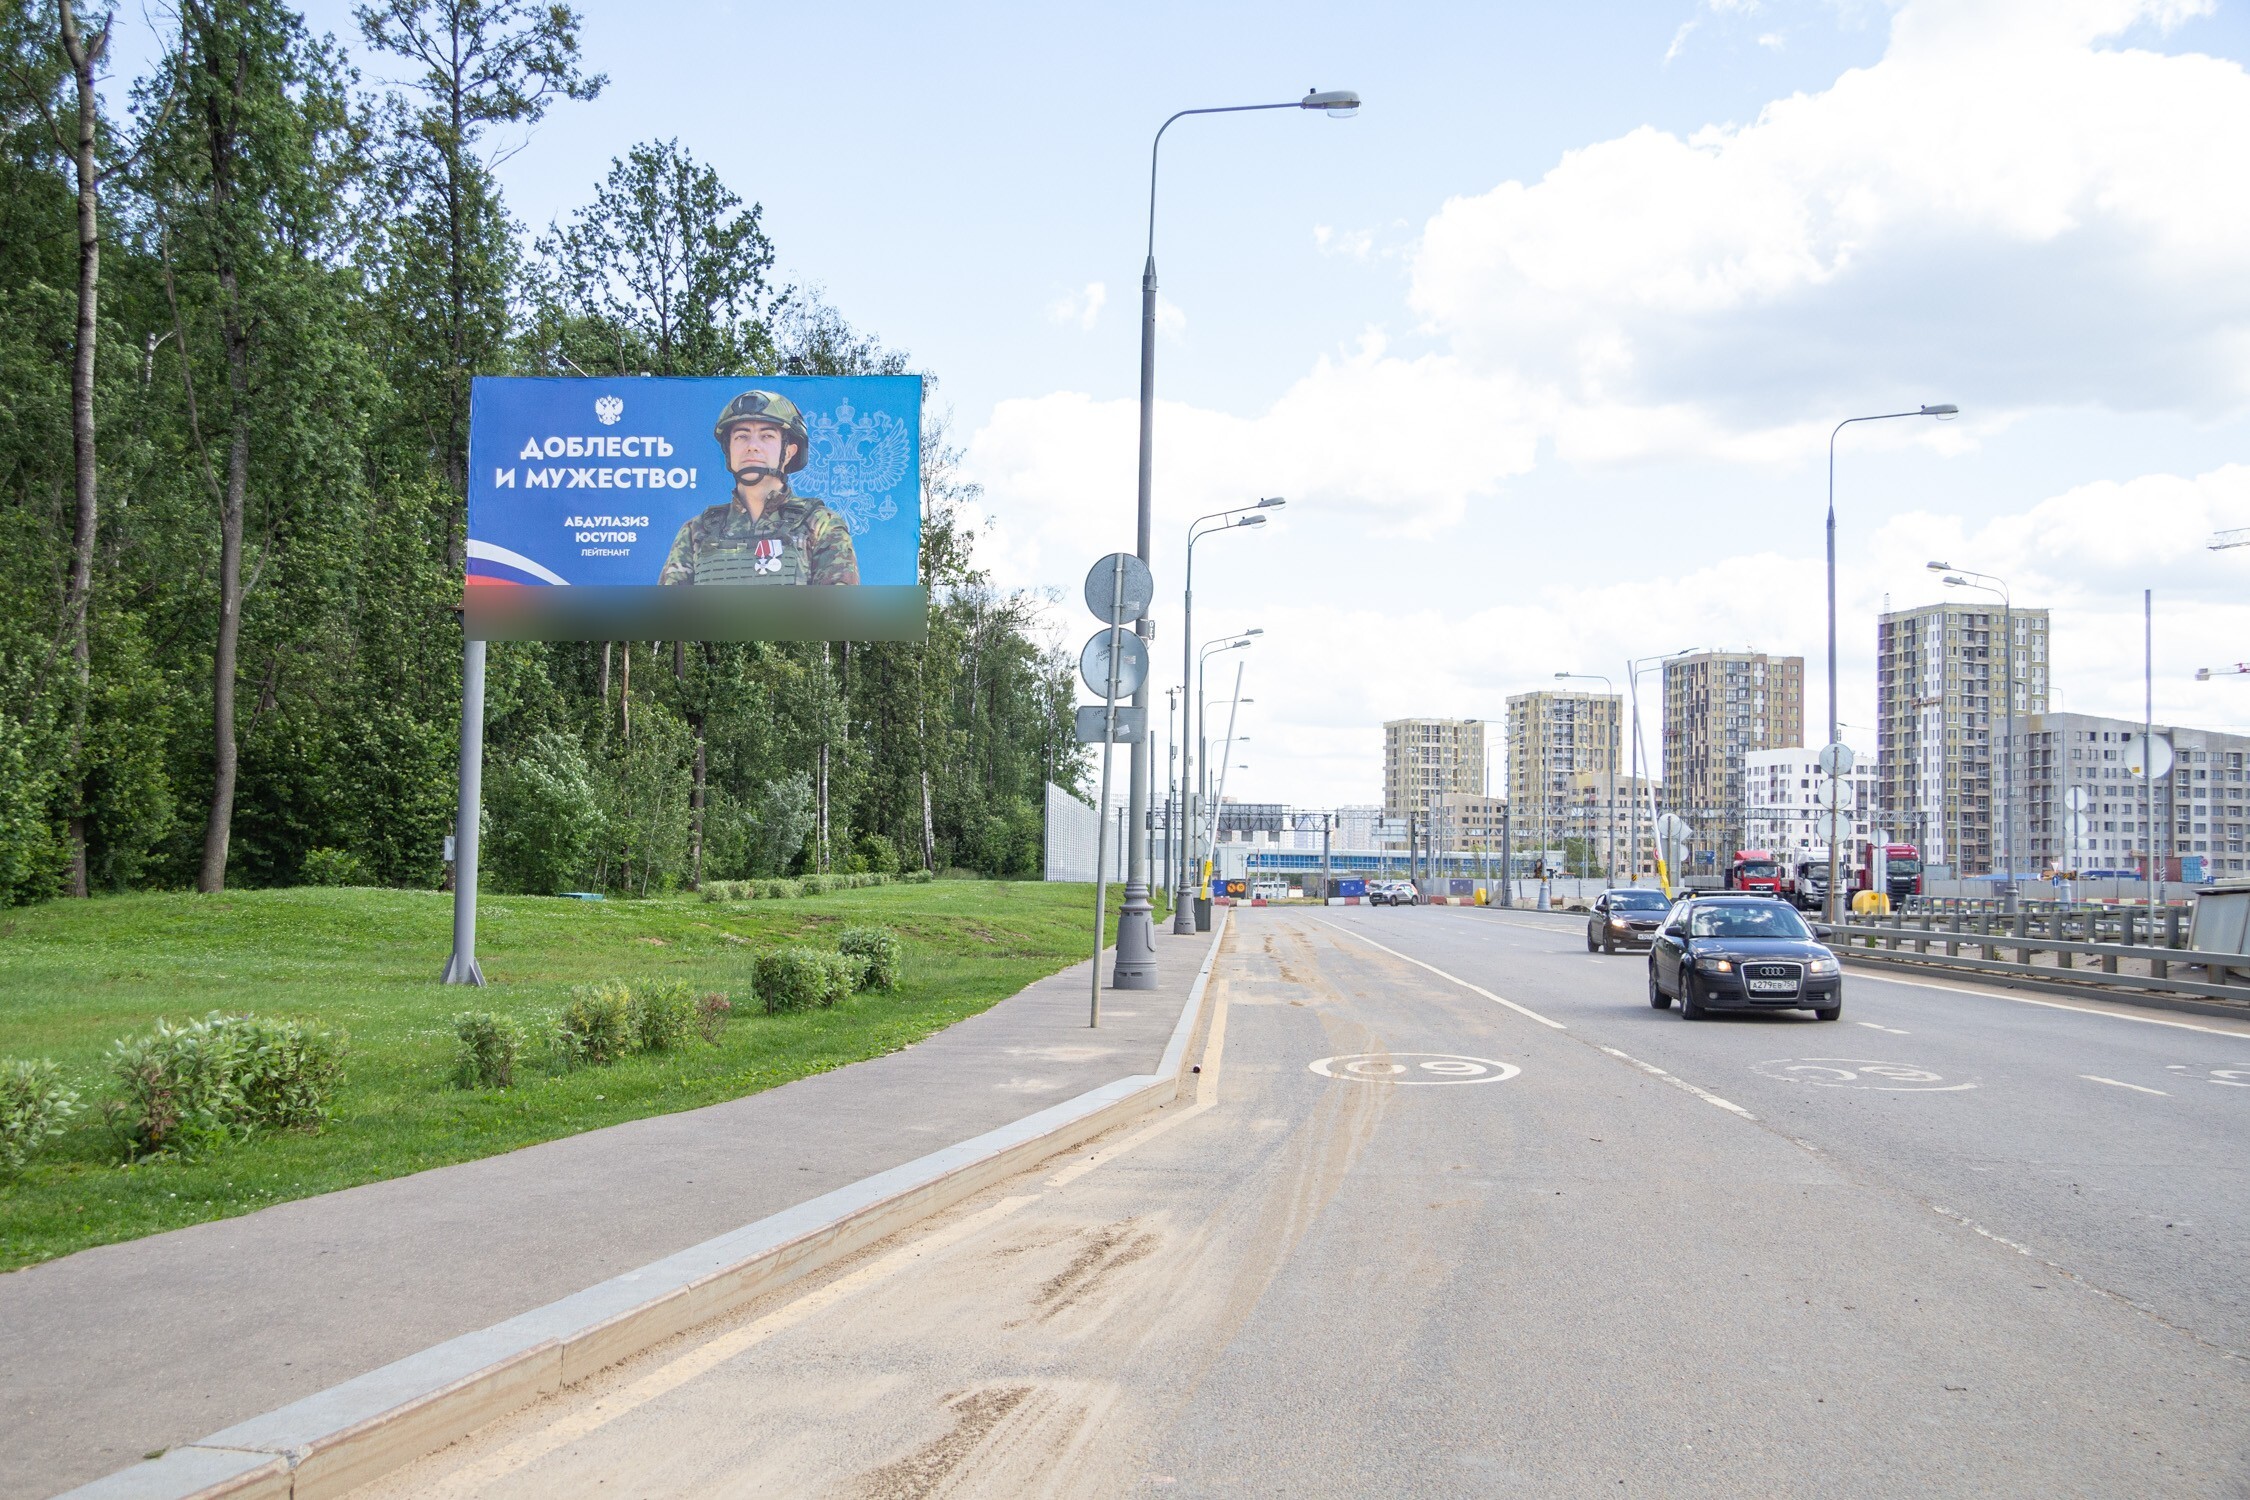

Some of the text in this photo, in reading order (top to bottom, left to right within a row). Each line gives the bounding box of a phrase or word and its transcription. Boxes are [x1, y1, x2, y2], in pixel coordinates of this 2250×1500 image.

[520, 436, 674, 460] ДОБЛЕСТЬ
[495, 467, 698, 489] И МУЖЕСТВО!
[564, 516, 649, 528] АБДУЛАЗИЗ
[575, 531, 637, 543] ЮСУПОВ
[580, 547, 631, 557] ЛЕЙТЕНАНТ
